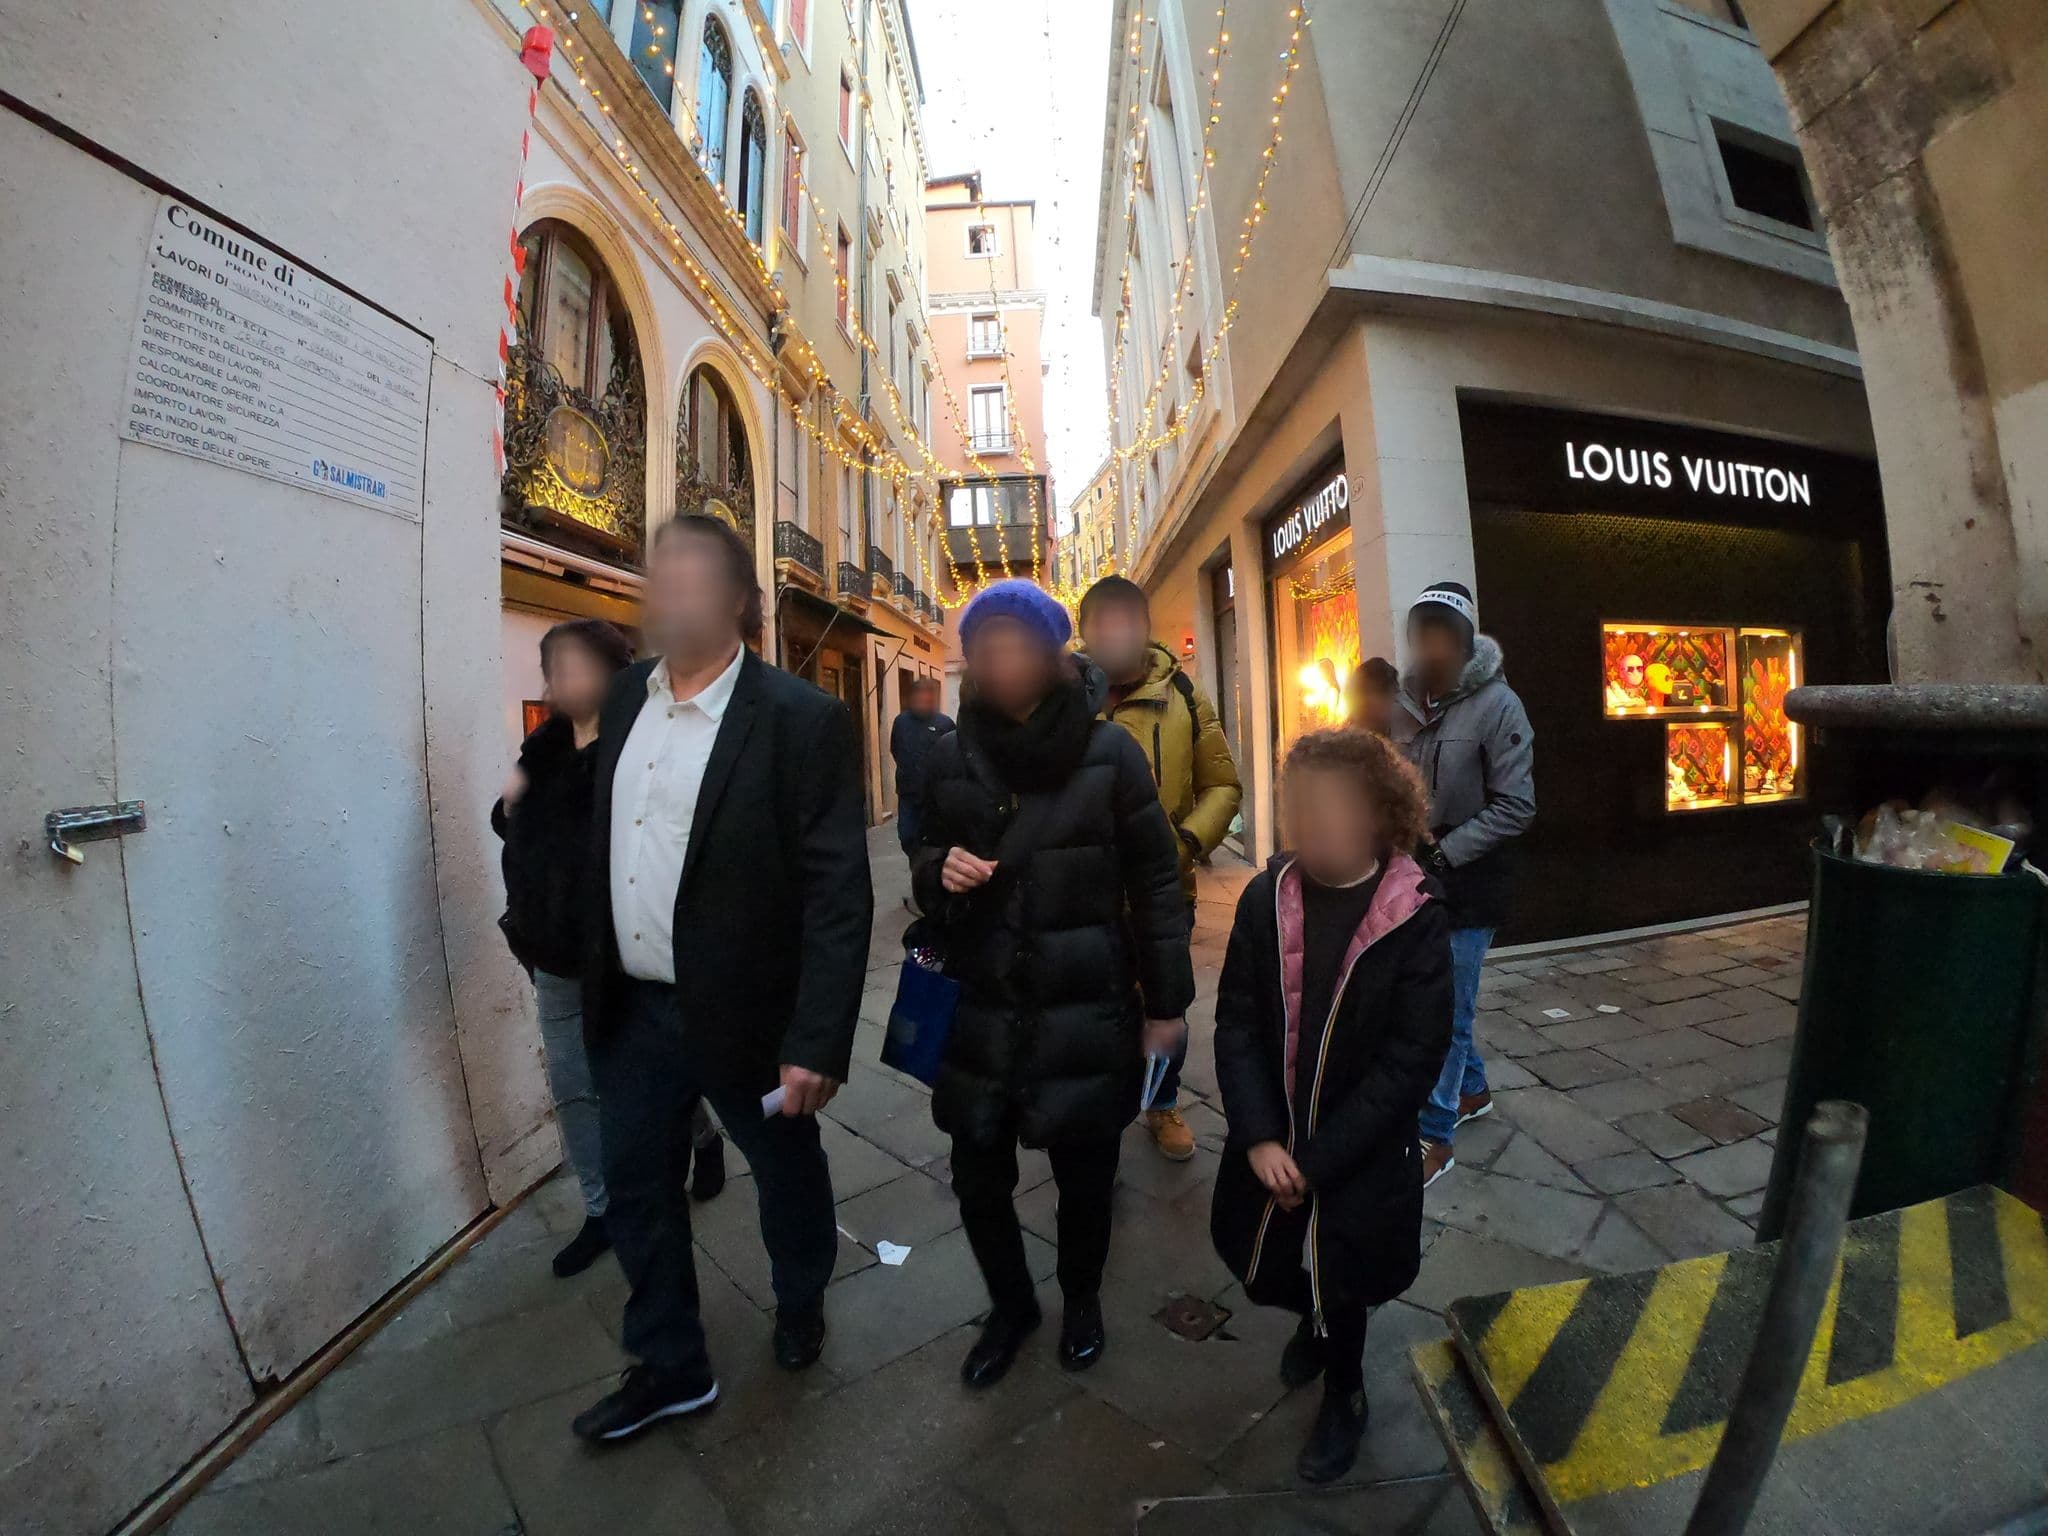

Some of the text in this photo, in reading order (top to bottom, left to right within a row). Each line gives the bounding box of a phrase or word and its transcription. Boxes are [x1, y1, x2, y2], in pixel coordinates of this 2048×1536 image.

[158, 247, 228, 287] LAVORI DI
[167, 205, 294, 287] Comune di
[152, 279, 210, 311] COSTRUIRE
[153, 271, 208, 300] PERMESSO
[210, 296, 220, 308] DI
[225, 260, 294, 301] PROVINCIA
[298, 298, 310, 309] DI
[149, 294, 226, 333] COMMITTENTE
[143, 325, 263, 379] DIRETTORE DEI LAVORI
[145, 310, 220, 346] PROGETTISTA
[223, 340, 281, 372] DELL'OPERA
[138, 355, 219, 391] CALCOLATORE
[221, 386, 254, 404] OPERE
[257, 400, 267, 409] IN
[141, 339, 261, 393] RESPONSABILE LAVORI
[367, 371, 381, 384] DEL
[132, 403, 238, 444] DATA INIZIO LAVORI
[134, 387, 226, 425] IMPORTO LAVORI
[136, 371, 281, 429] COORDINATORE SICUREZZA
[129, 420, 200, 448] ESECUTORE
[202, 441, 234, 459] DELLE
[237, 452, 272, 470] OPERE
[330, 465, 386, 498] SALMISTRARI
[1566, 441, 1811, 507] LOUIS VUITTON
[1273, 512, 1302, 558] LOUIS
